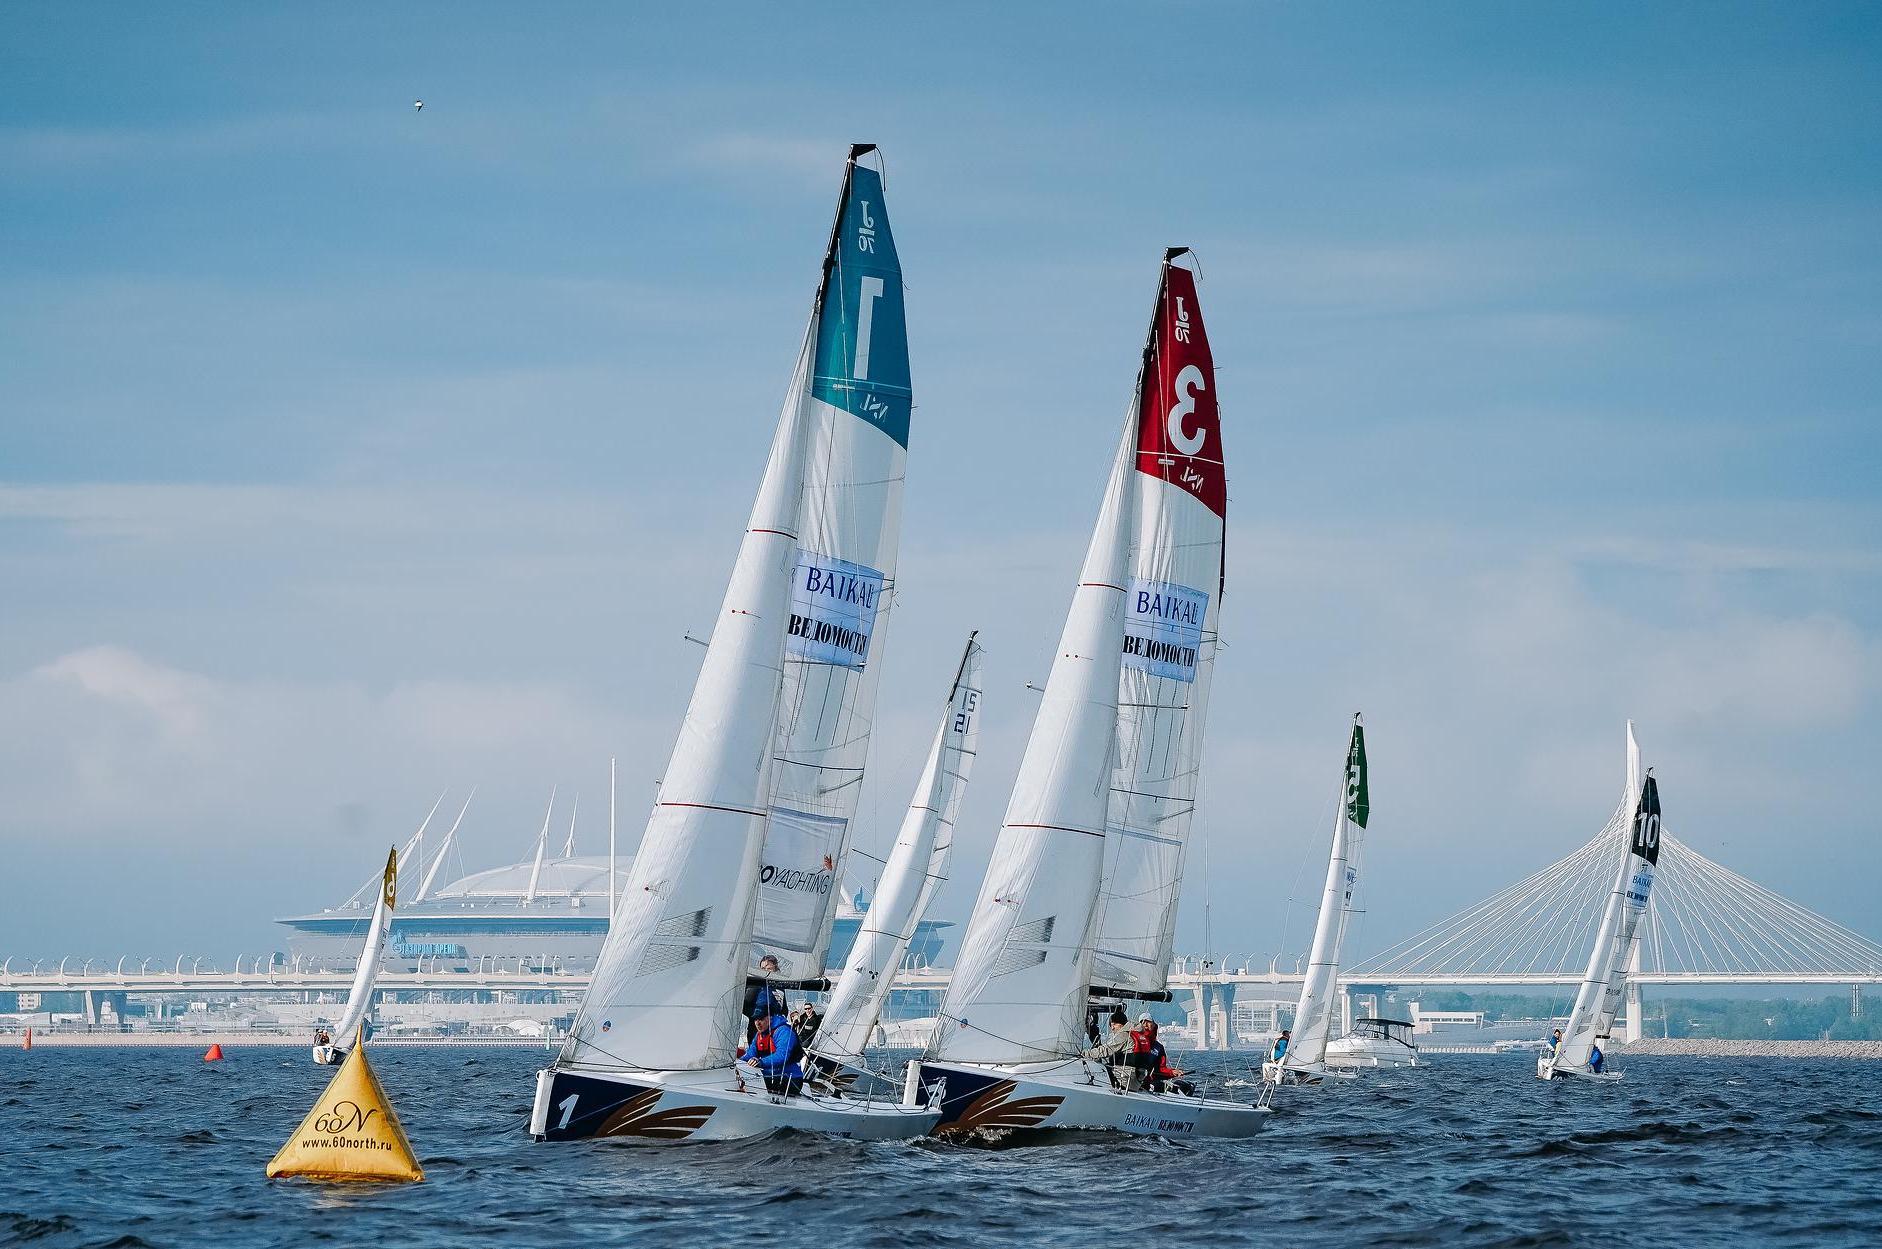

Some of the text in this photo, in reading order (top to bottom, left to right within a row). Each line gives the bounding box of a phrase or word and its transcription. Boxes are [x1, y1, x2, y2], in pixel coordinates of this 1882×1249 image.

[787, 613, 868, 656] ВЕДОМОСТИ
[1122, 634, 1196, 668] ВЕДОМОСТИ
[954, 712, 971, 735] 21
[1637, 812, 1660, 849] 10
[761, 864, 830, 895] OYACHTING
[558, 1094, 580, 1129] 1
[302, 1136, 392, 1151] www.60north.ru
